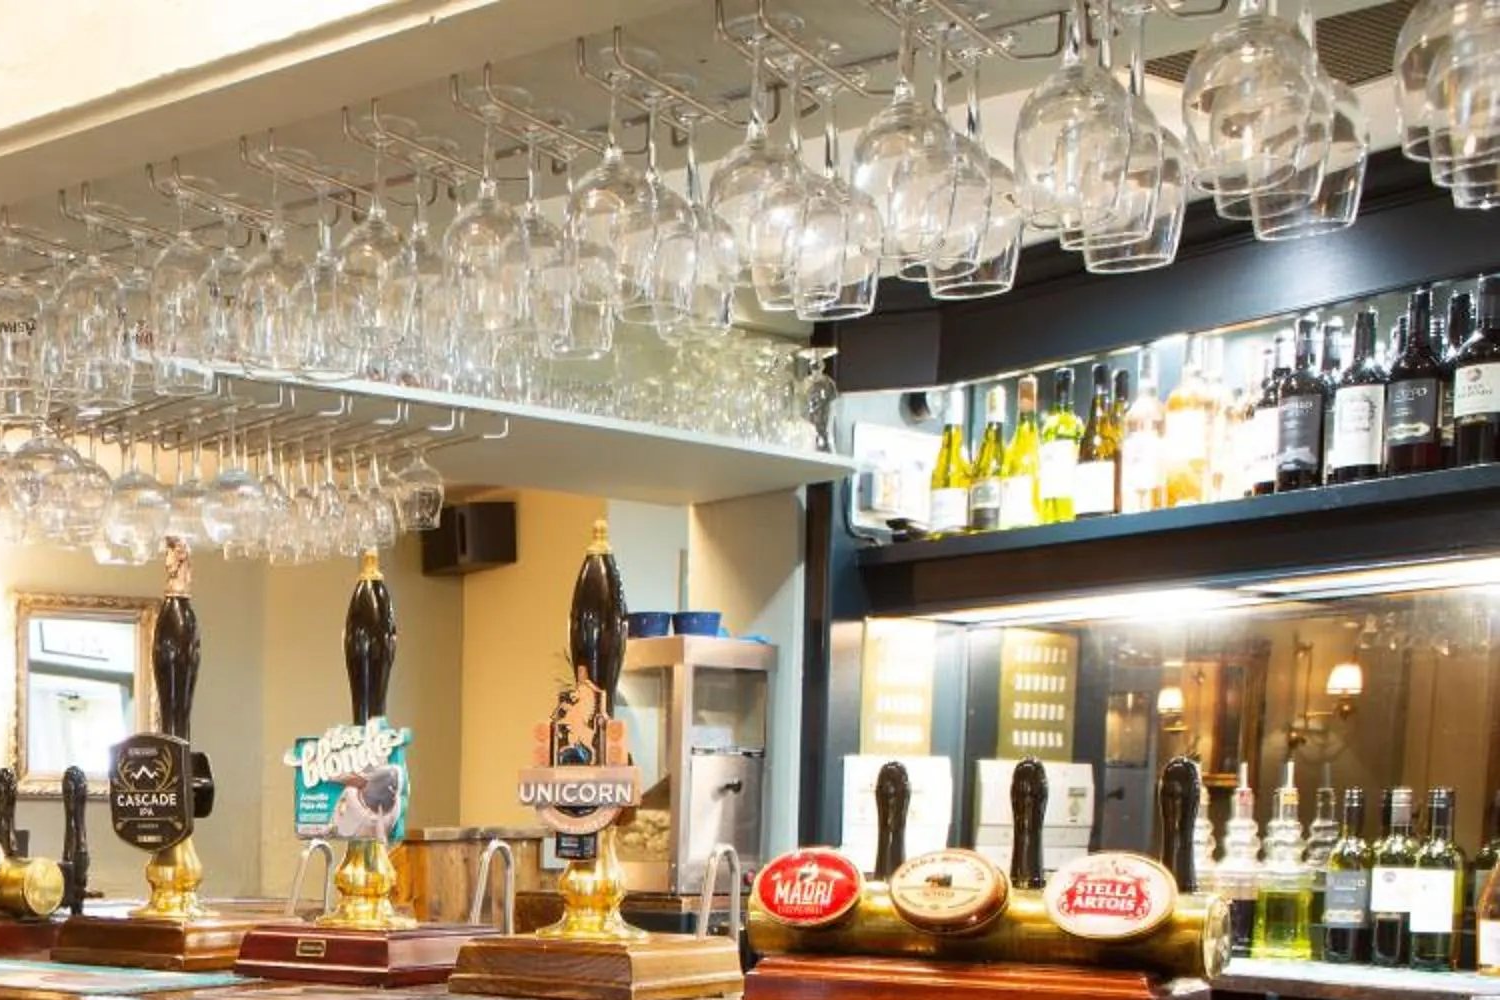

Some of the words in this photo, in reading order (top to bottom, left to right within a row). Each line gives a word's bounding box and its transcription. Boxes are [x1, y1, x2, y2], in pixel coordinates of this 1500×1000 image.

[117, 793, 177, 807] CASCADE
[520, 782, 632, 803] UNICORN
[139, 807, 155, 816] IPA
[1076, 880, 1137, 897] STELLA
[1073, 895, 1136, 911] ARTOIS
